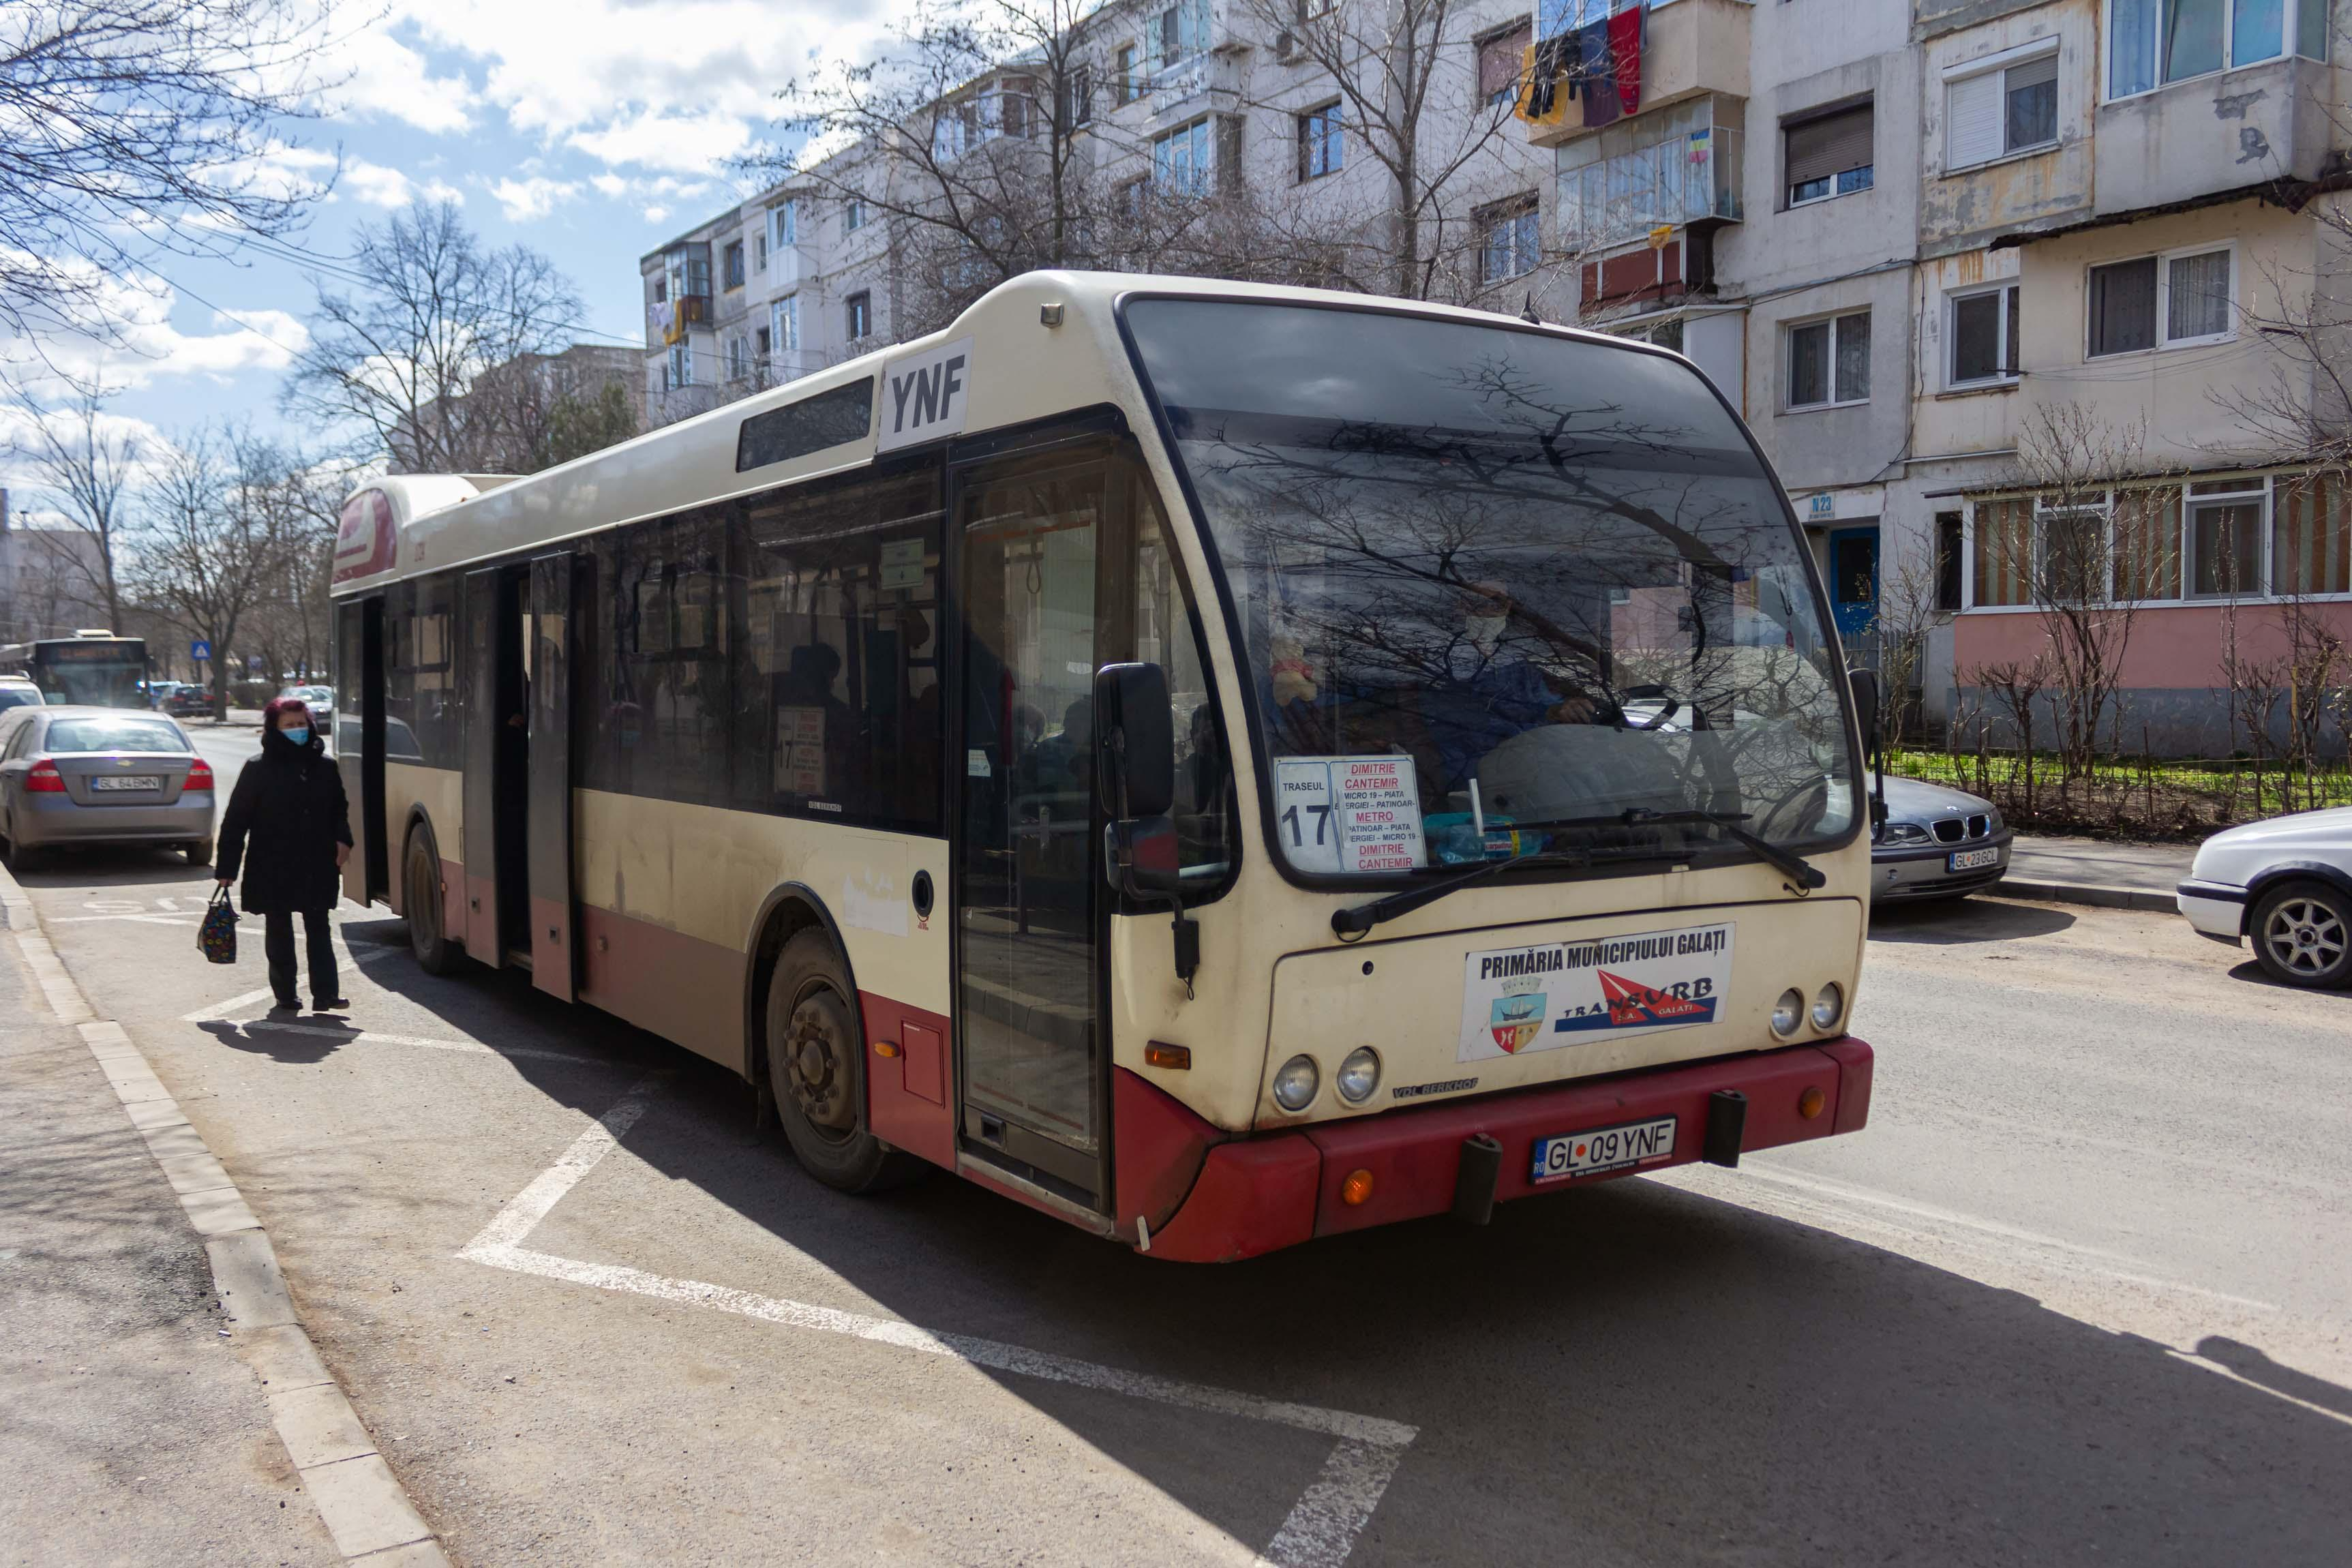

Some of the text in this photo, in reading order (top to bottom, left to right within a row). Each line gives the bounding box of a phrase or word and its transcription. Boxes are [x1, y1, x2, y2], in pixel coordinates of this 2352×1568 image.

[892, 354, 965, 433] YNF
[1820, 496, 1832, 511] 23
[779, 740, 793, 769] 17
[1351, 764, 1396, 774] DIMITRIE
[1283, 782, 1325, 791] TRASEUL
[1345, 778, 1398, 789] CANTEMIR
[1344, 791, 1368, 800] MICRO
[1384, 790, 1404, 798] PIATA
[1335, 802, 1369, 810] EERGIEI
[1357, 811, 1393, 822] METRO
[1282, 804, 1331, 847] 17
[1359, 844, 1405, 855] DIMITRIE
[1359, 858, 1413, 869] CANTEMIR
[1955, 849, 1996, 867] GL 23 GCL
[1480, 948, 1564, 980] PRIMĂRIA
[1567, 936, 1674, 971] MUNICIPIULUI
[1565, 977, 1713, 1018] TRANSURB
[1393, 1078, 1479, 1099] VDL BERKHOF
[1548, 1140, 1580, 1171] GL
[1590, 1133, 1619, 1164] 09
[1623, 1123, 1672, 1158] YNF
[1533, 1161, 1545, 1174] RO
